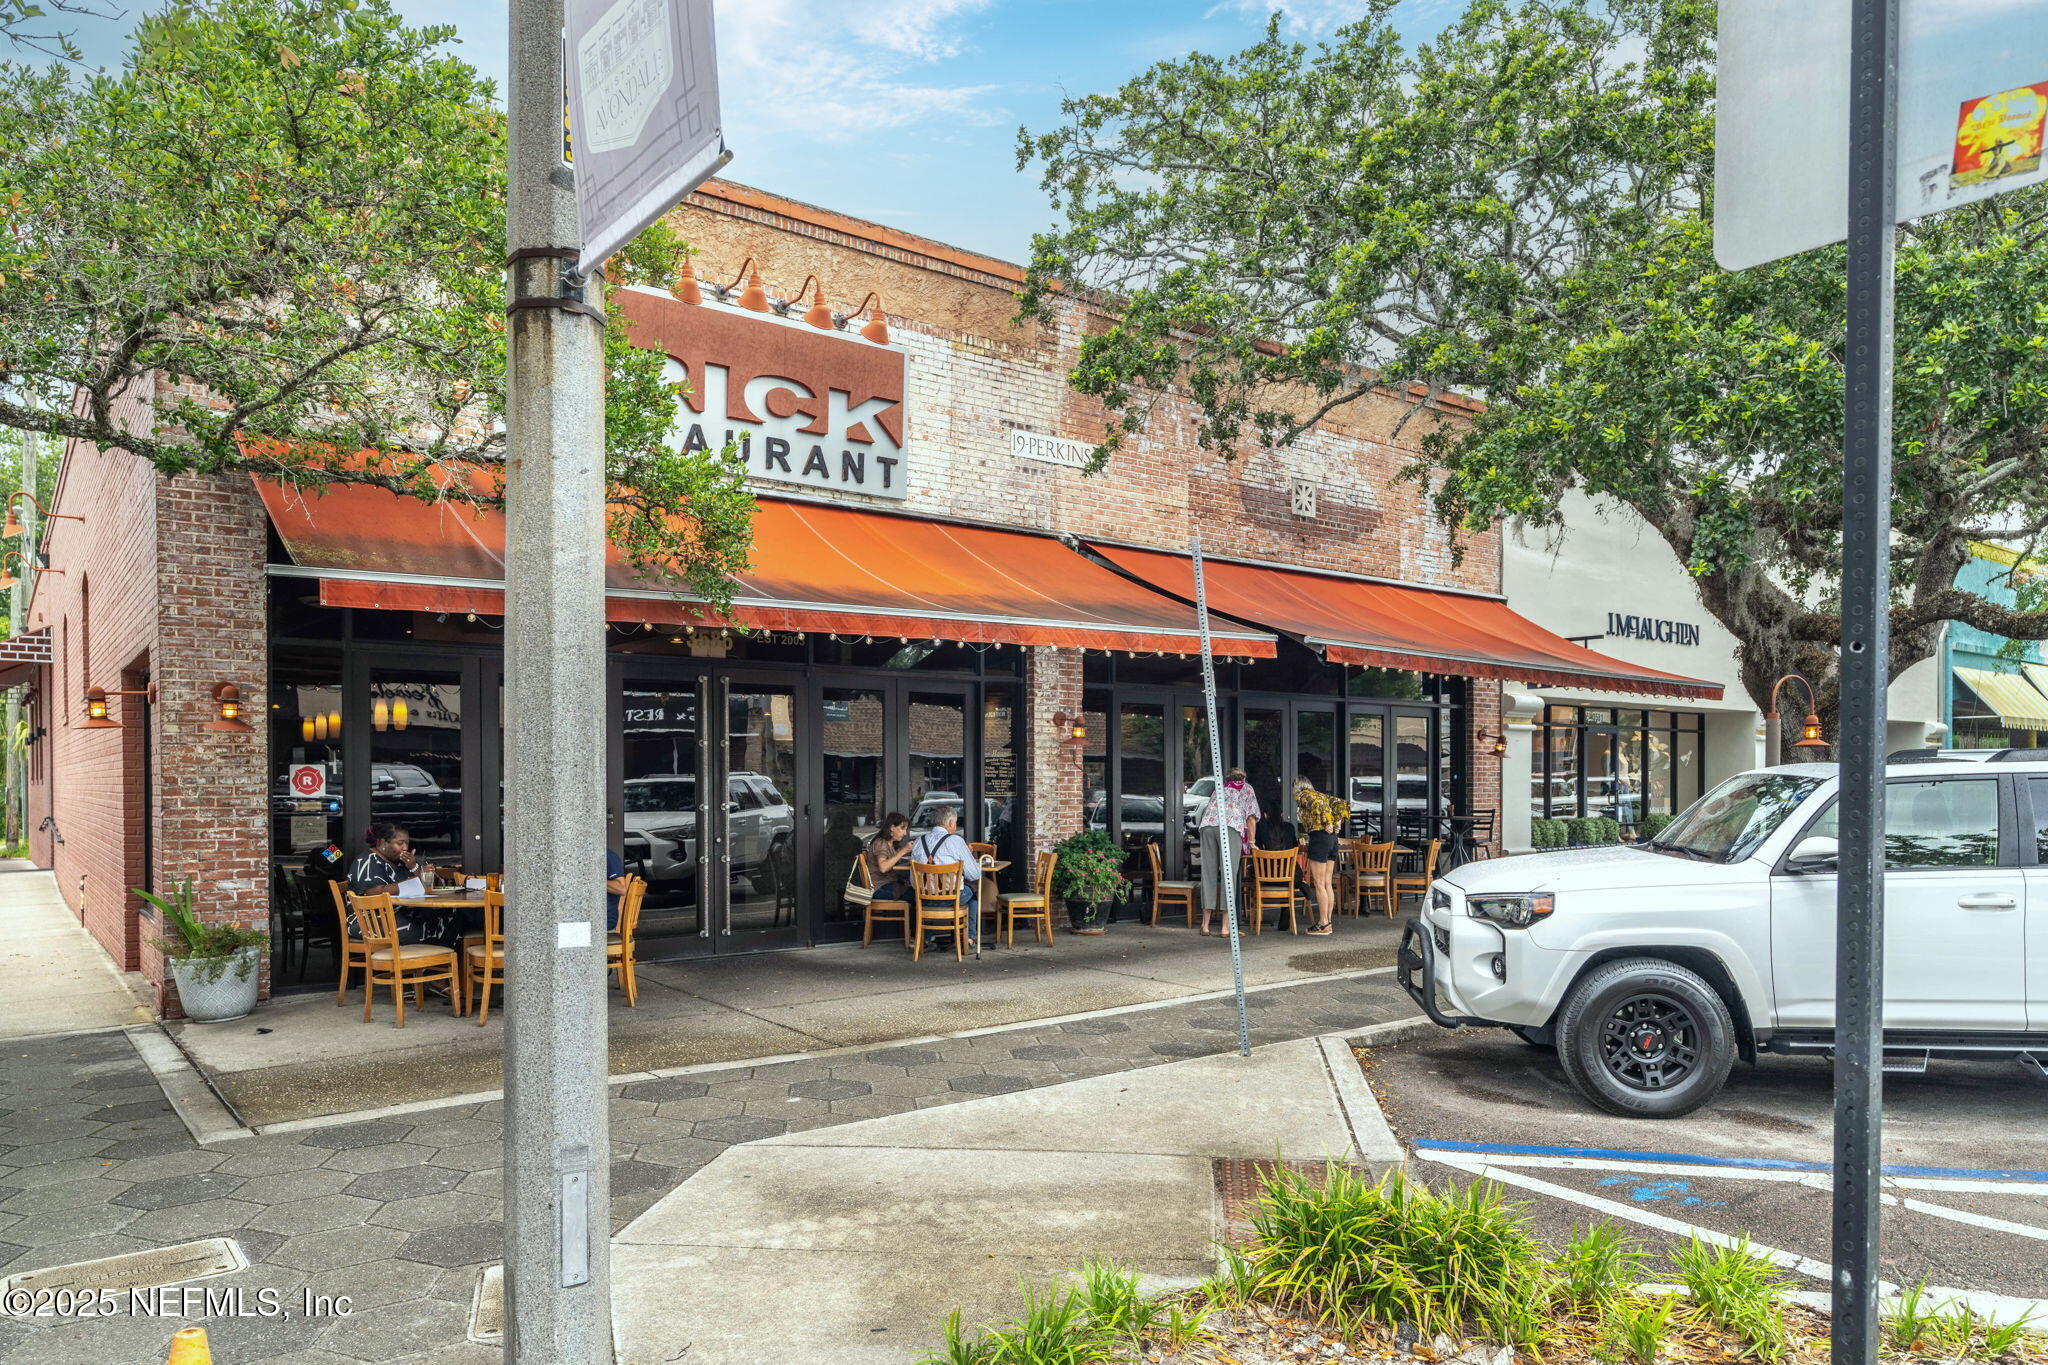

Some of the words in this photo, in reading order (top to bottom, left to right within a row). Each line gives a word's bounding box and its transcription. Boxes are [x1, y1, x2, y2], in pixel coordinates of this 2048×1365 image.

[594, 48, 665, 137] AVONDALE
[681, 423, 899, 488] AURANT
[303, 775, 313, 786] R
[88, 1264, 163, 1283] ELECTRIC
